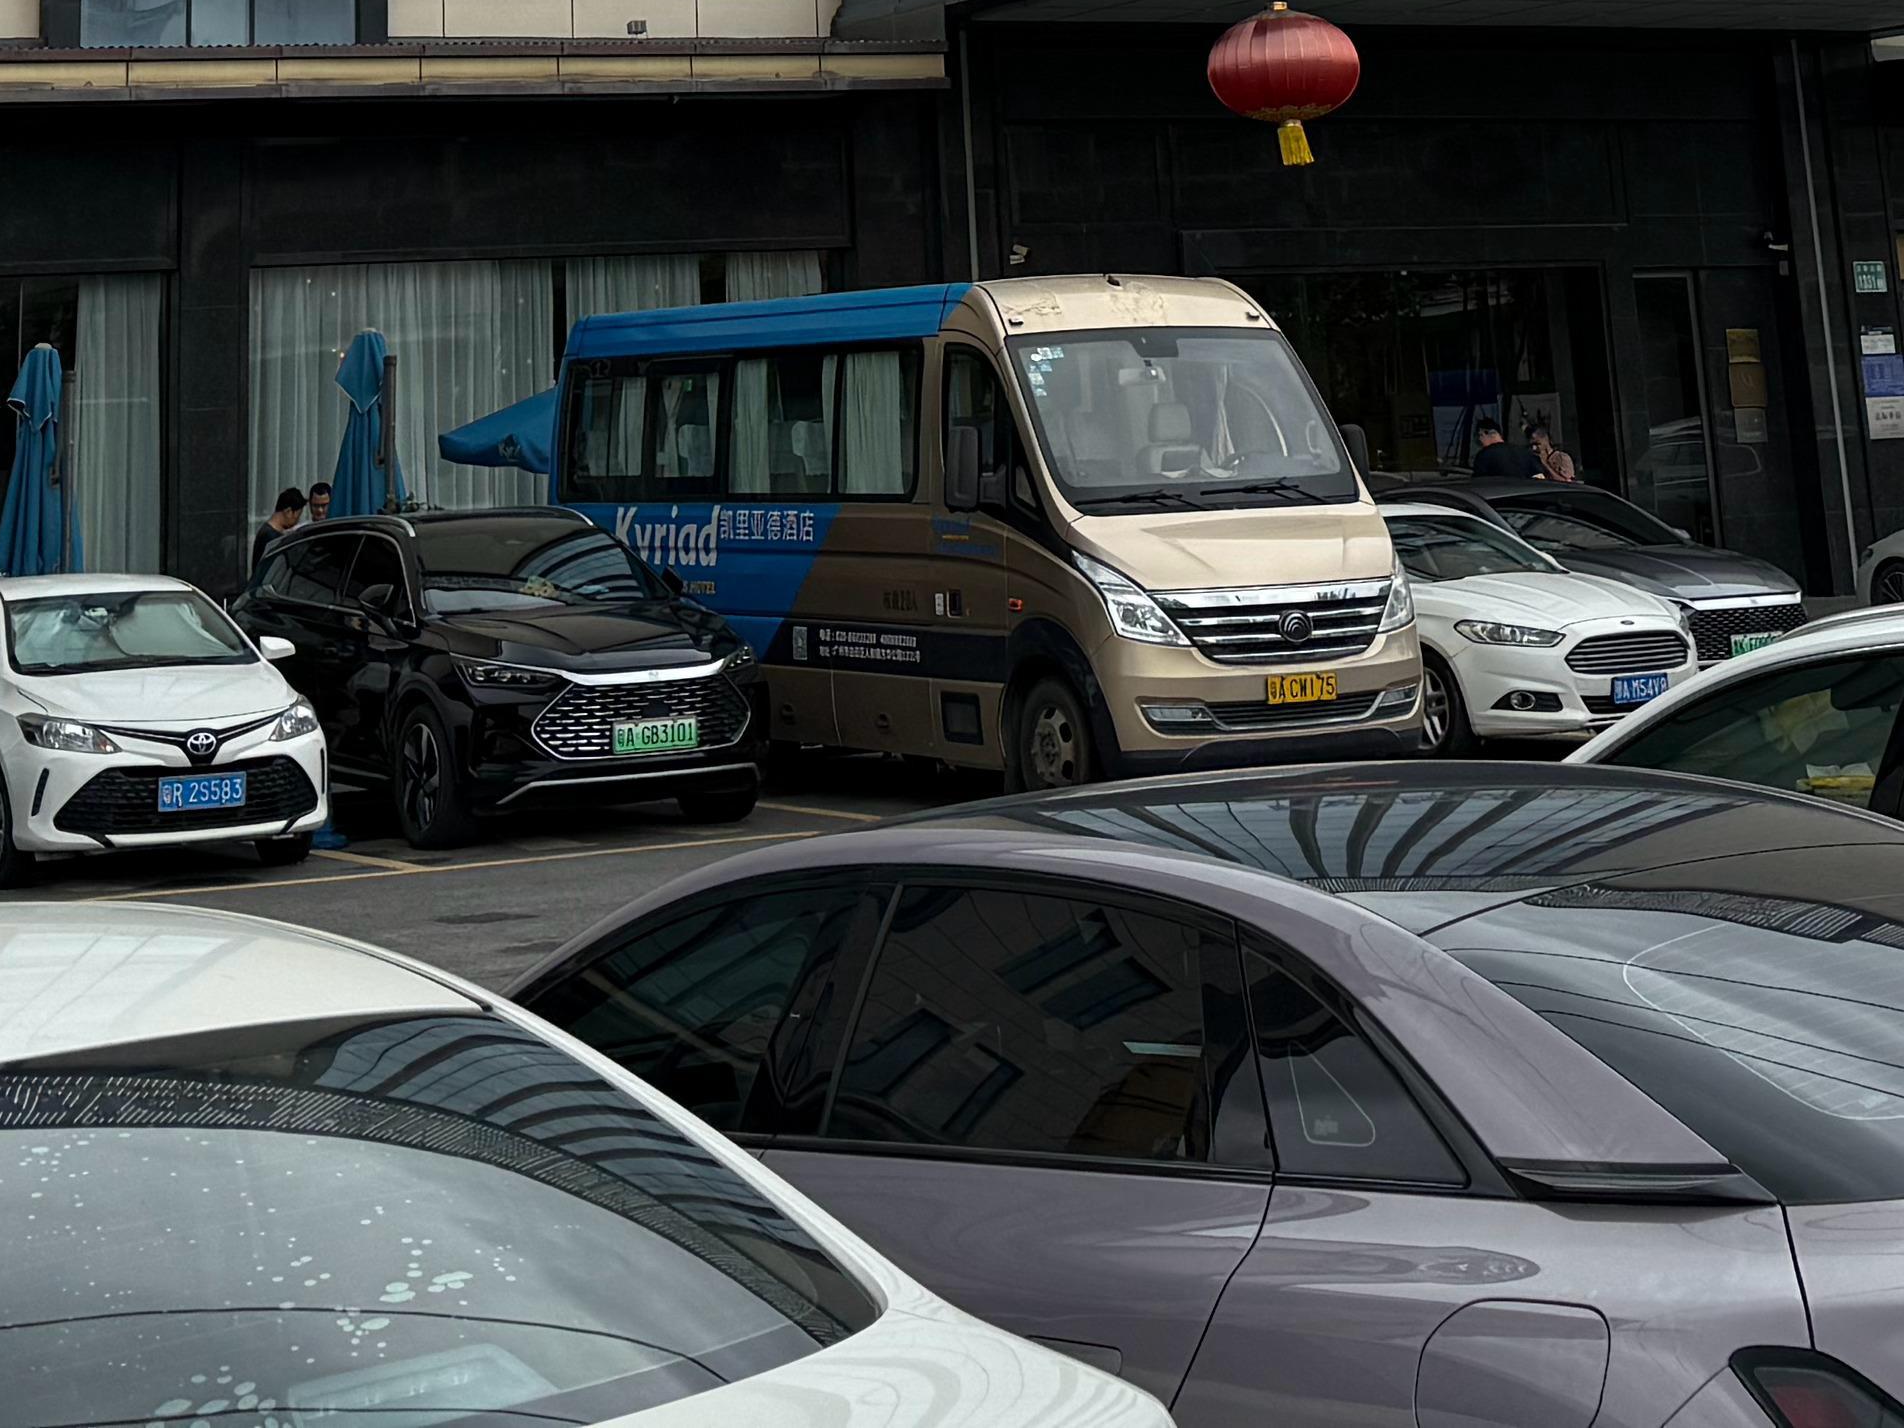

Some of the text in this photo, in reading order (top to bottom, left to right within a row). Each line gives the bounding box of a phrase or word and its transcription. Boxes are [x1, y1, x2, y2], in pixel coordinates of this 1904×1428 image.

[615, 505, 721, 567] Kyriad
[720, 509, 815, 542] 凯里亚德酒店
